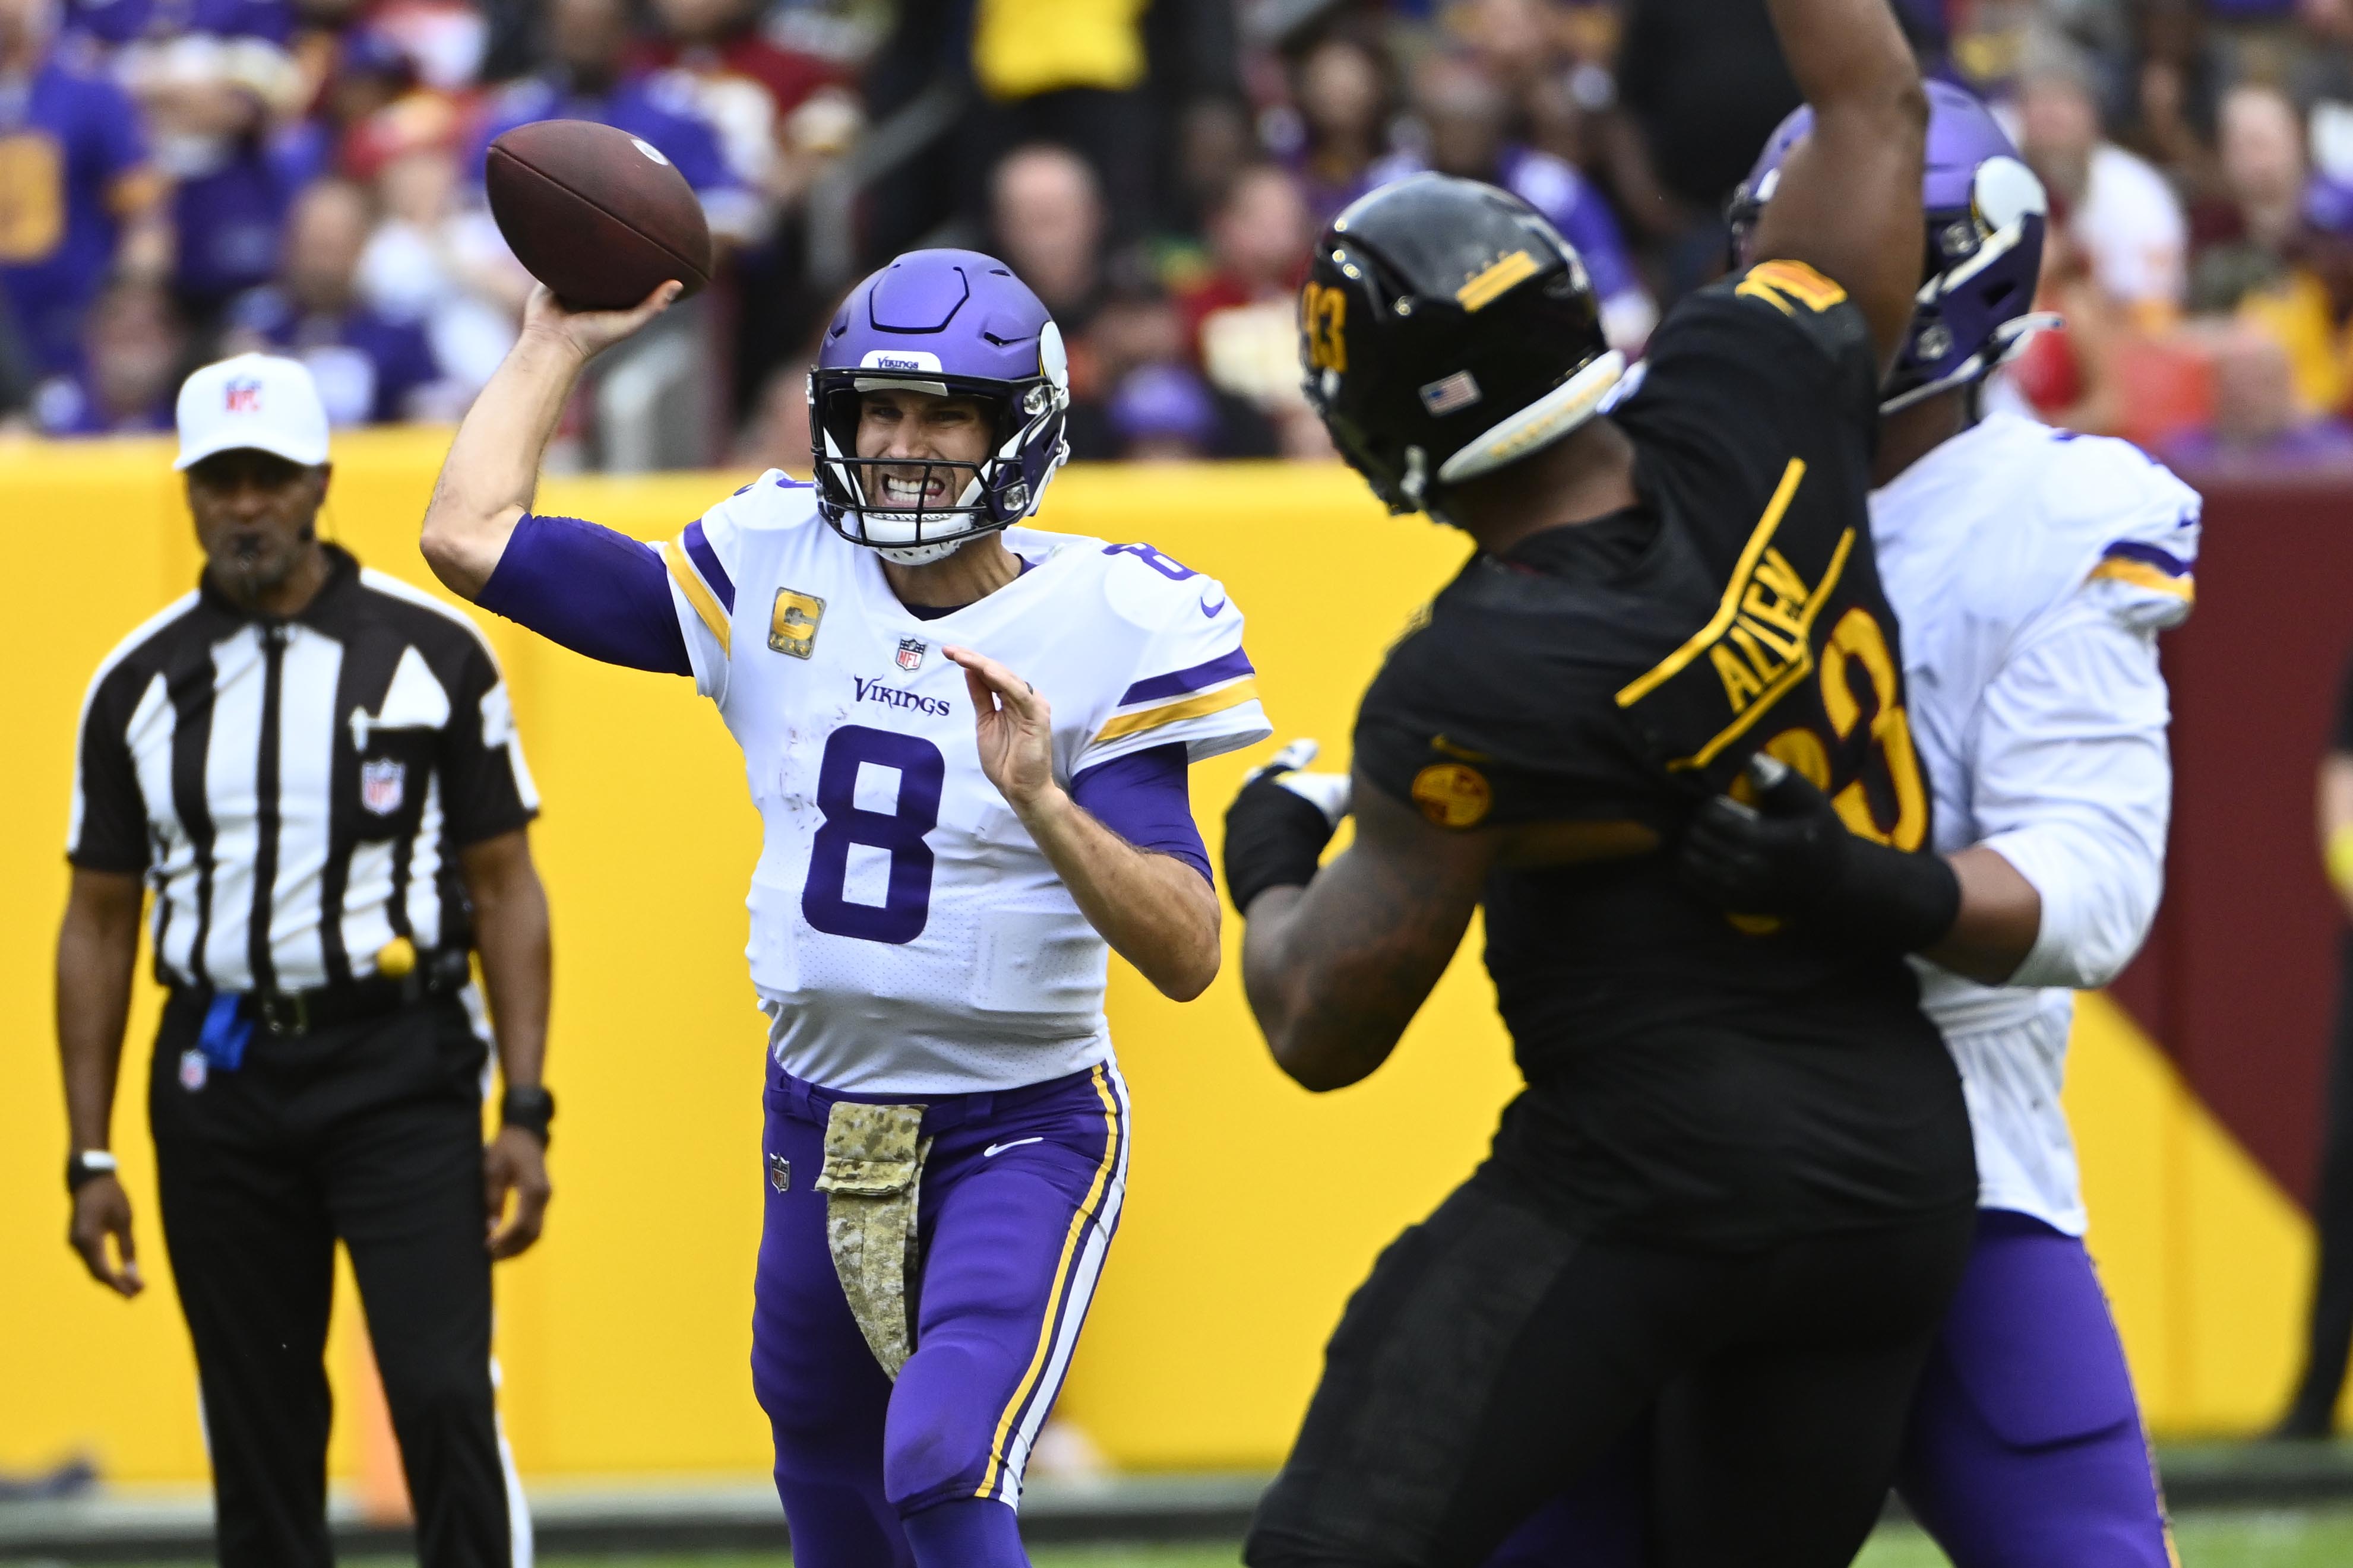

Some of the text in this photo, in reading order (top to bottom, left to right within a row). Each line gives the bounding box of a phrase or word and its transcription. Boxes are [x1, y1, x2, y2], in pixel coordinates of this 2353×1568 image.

[1302, 280, 1348, 373] 93
[773, 592, 819, 641] C
[898, 650, 919, 668] NFL
[802, 724, 945, 945] 8
